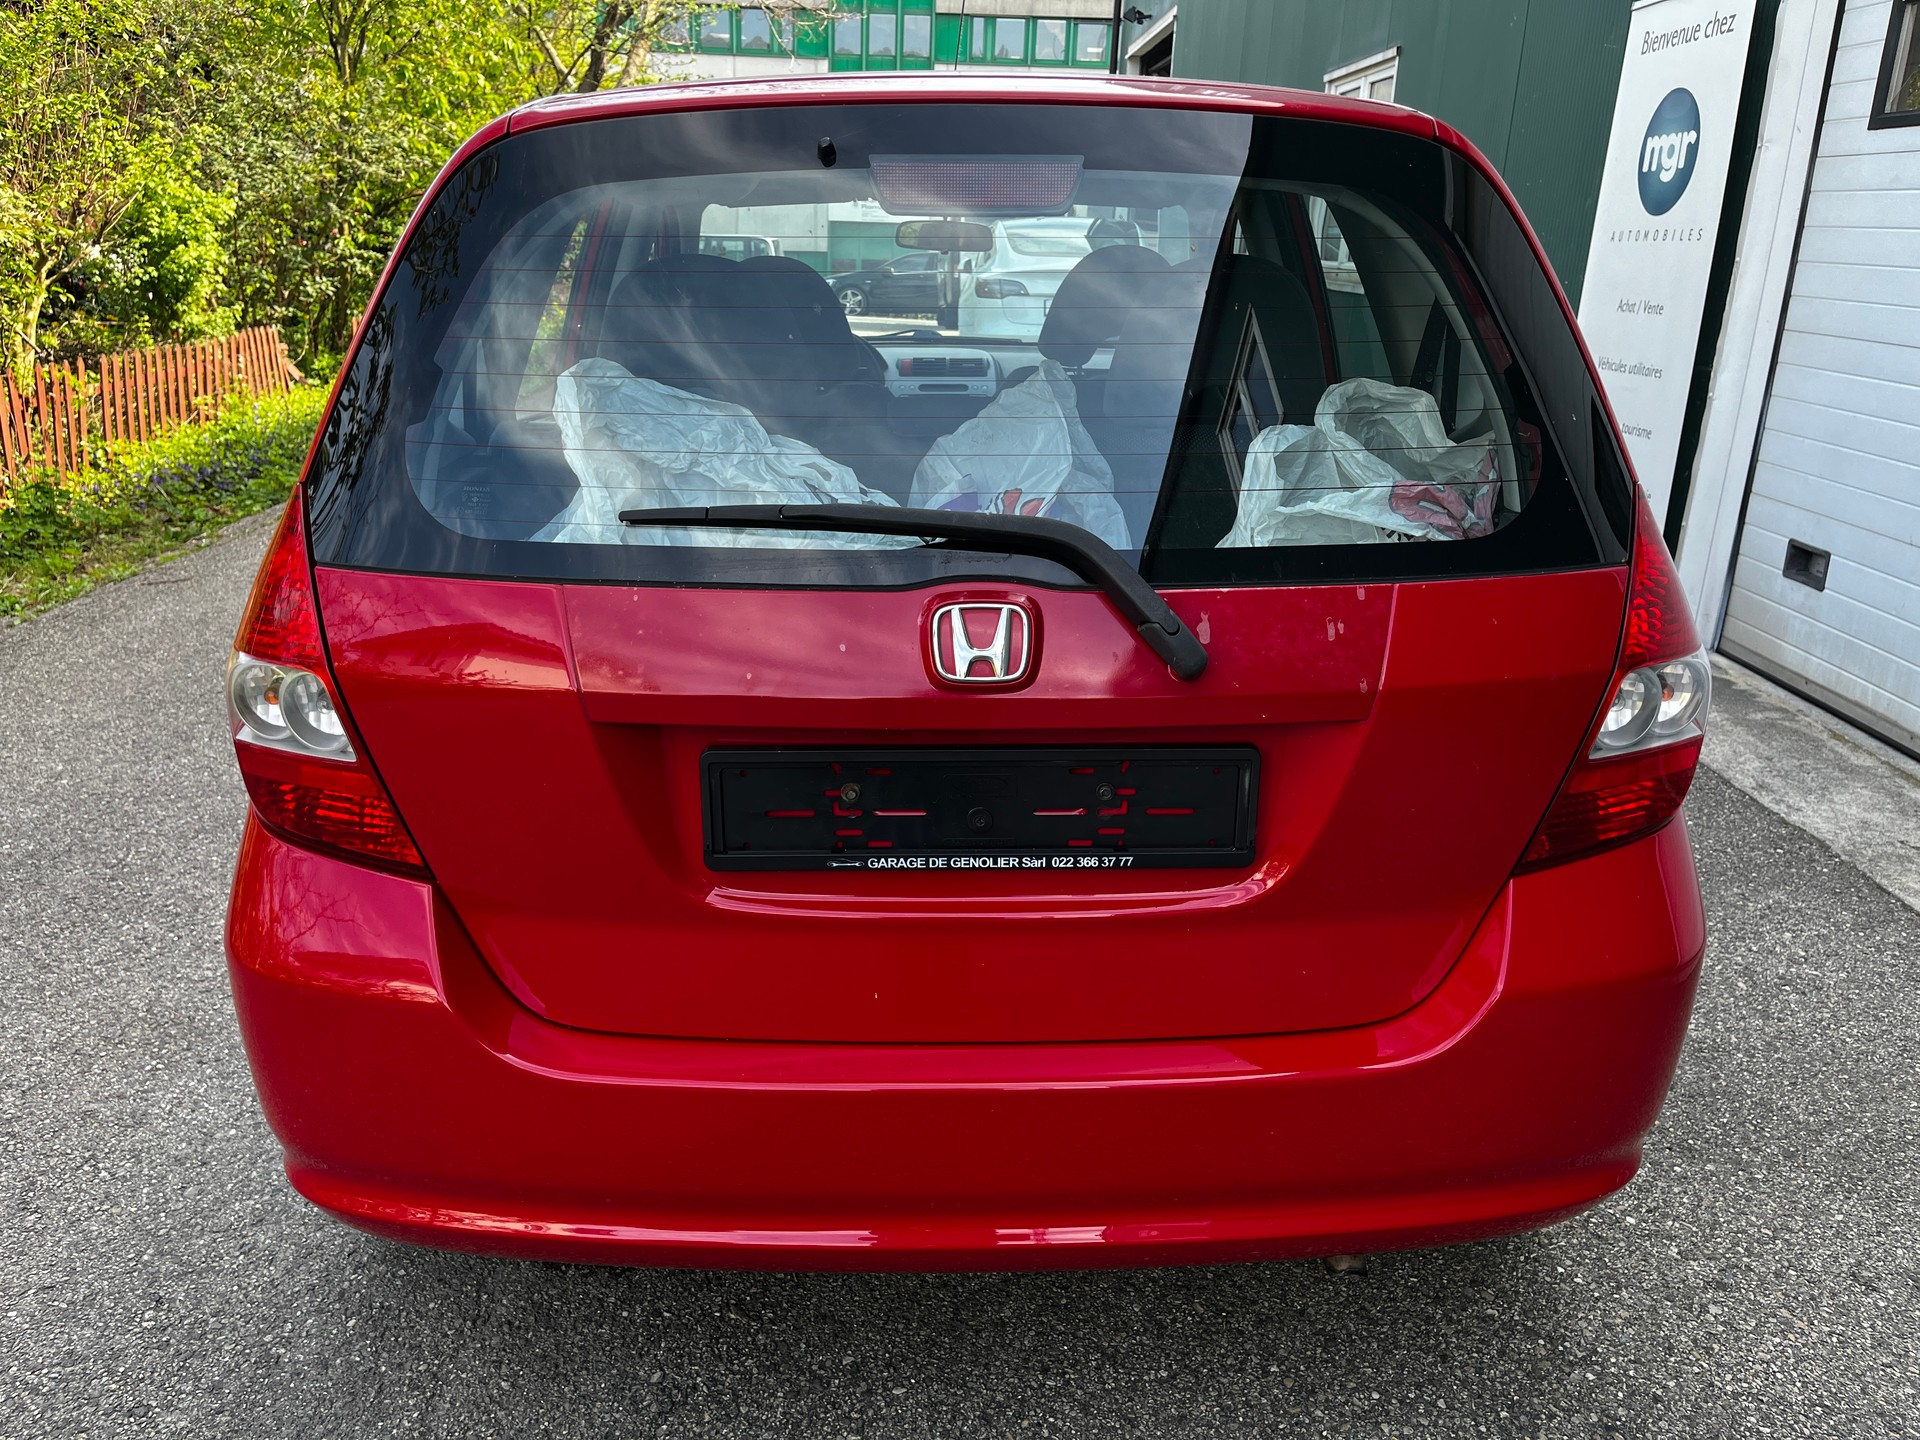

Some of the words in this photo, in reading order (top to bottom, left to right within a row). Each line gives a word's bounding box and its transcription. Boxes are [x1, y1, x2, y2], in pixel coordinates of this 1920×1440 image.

[1641, 23, 1701, 55] Bienvenue
[1704, 11, 1737, 39] chez
[1642, 130, 1698, 183] mgr
[1610, 228, 1704, 242] AUTOMOBILES
[1616, 299, 1637, 313] Achat
[1643, 299, 1665, 316] Vente
[1598, 355, 1628, 374] Véhicules
[1628, 362, 1663, 379] utilitaires
[1621, 423, 1653, 440] tourisme
[867, 857, 926, 869] GARAGE
[929, 857, 948, 868] DE
[950, 856, 1020, 868] GENOLIER
[1022, 856, 1046, 868] Sàrl
[1051, 856, 1074, 868] 022
[1076, 856, 1099, 868] 366
[1101, 856, 1116, 868] 37
[1119, 856, 1134, 867] 77
